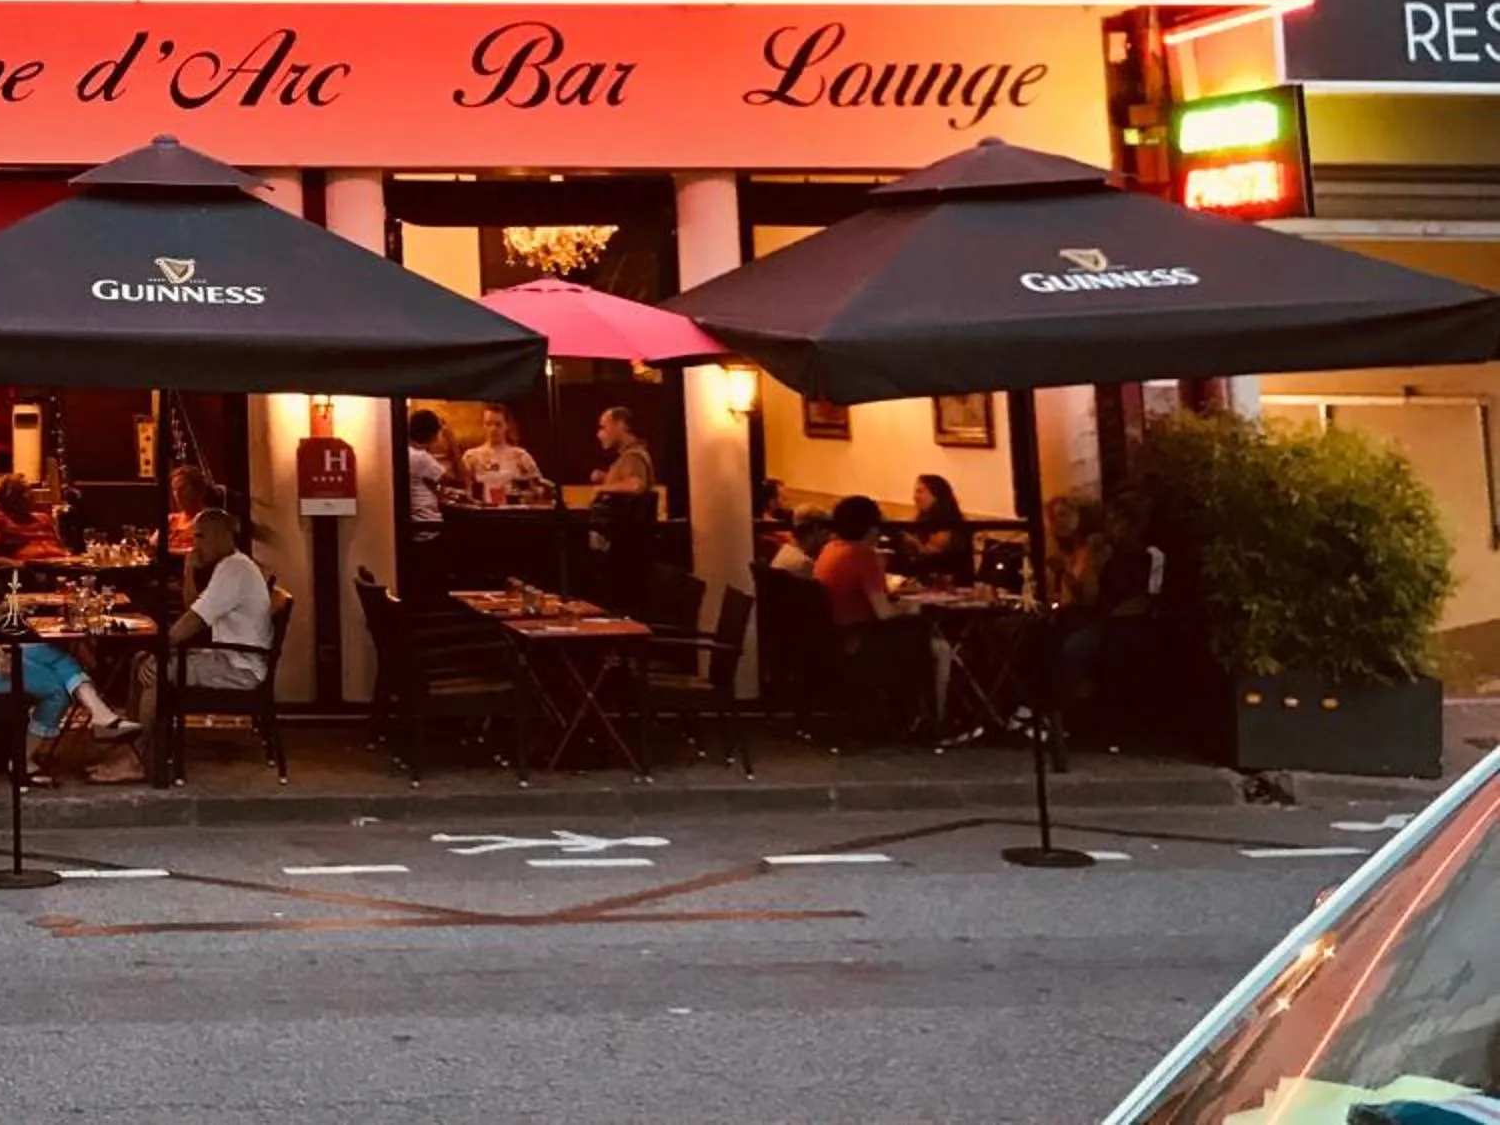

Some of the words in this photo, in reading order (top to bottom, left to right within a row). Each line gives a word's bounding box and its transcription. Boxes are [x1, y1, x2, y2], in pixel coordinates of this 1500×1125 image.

[75, 28, 353, 111] d'Arc
[452, 21, 638, 109] Bar
[741, 21, 1049, 131] Lounge
[91, 278, 266, 305] GUINNESS
[1020, 267, 1201, 293] GUINNESS
[323, 448, 348, 472] H
